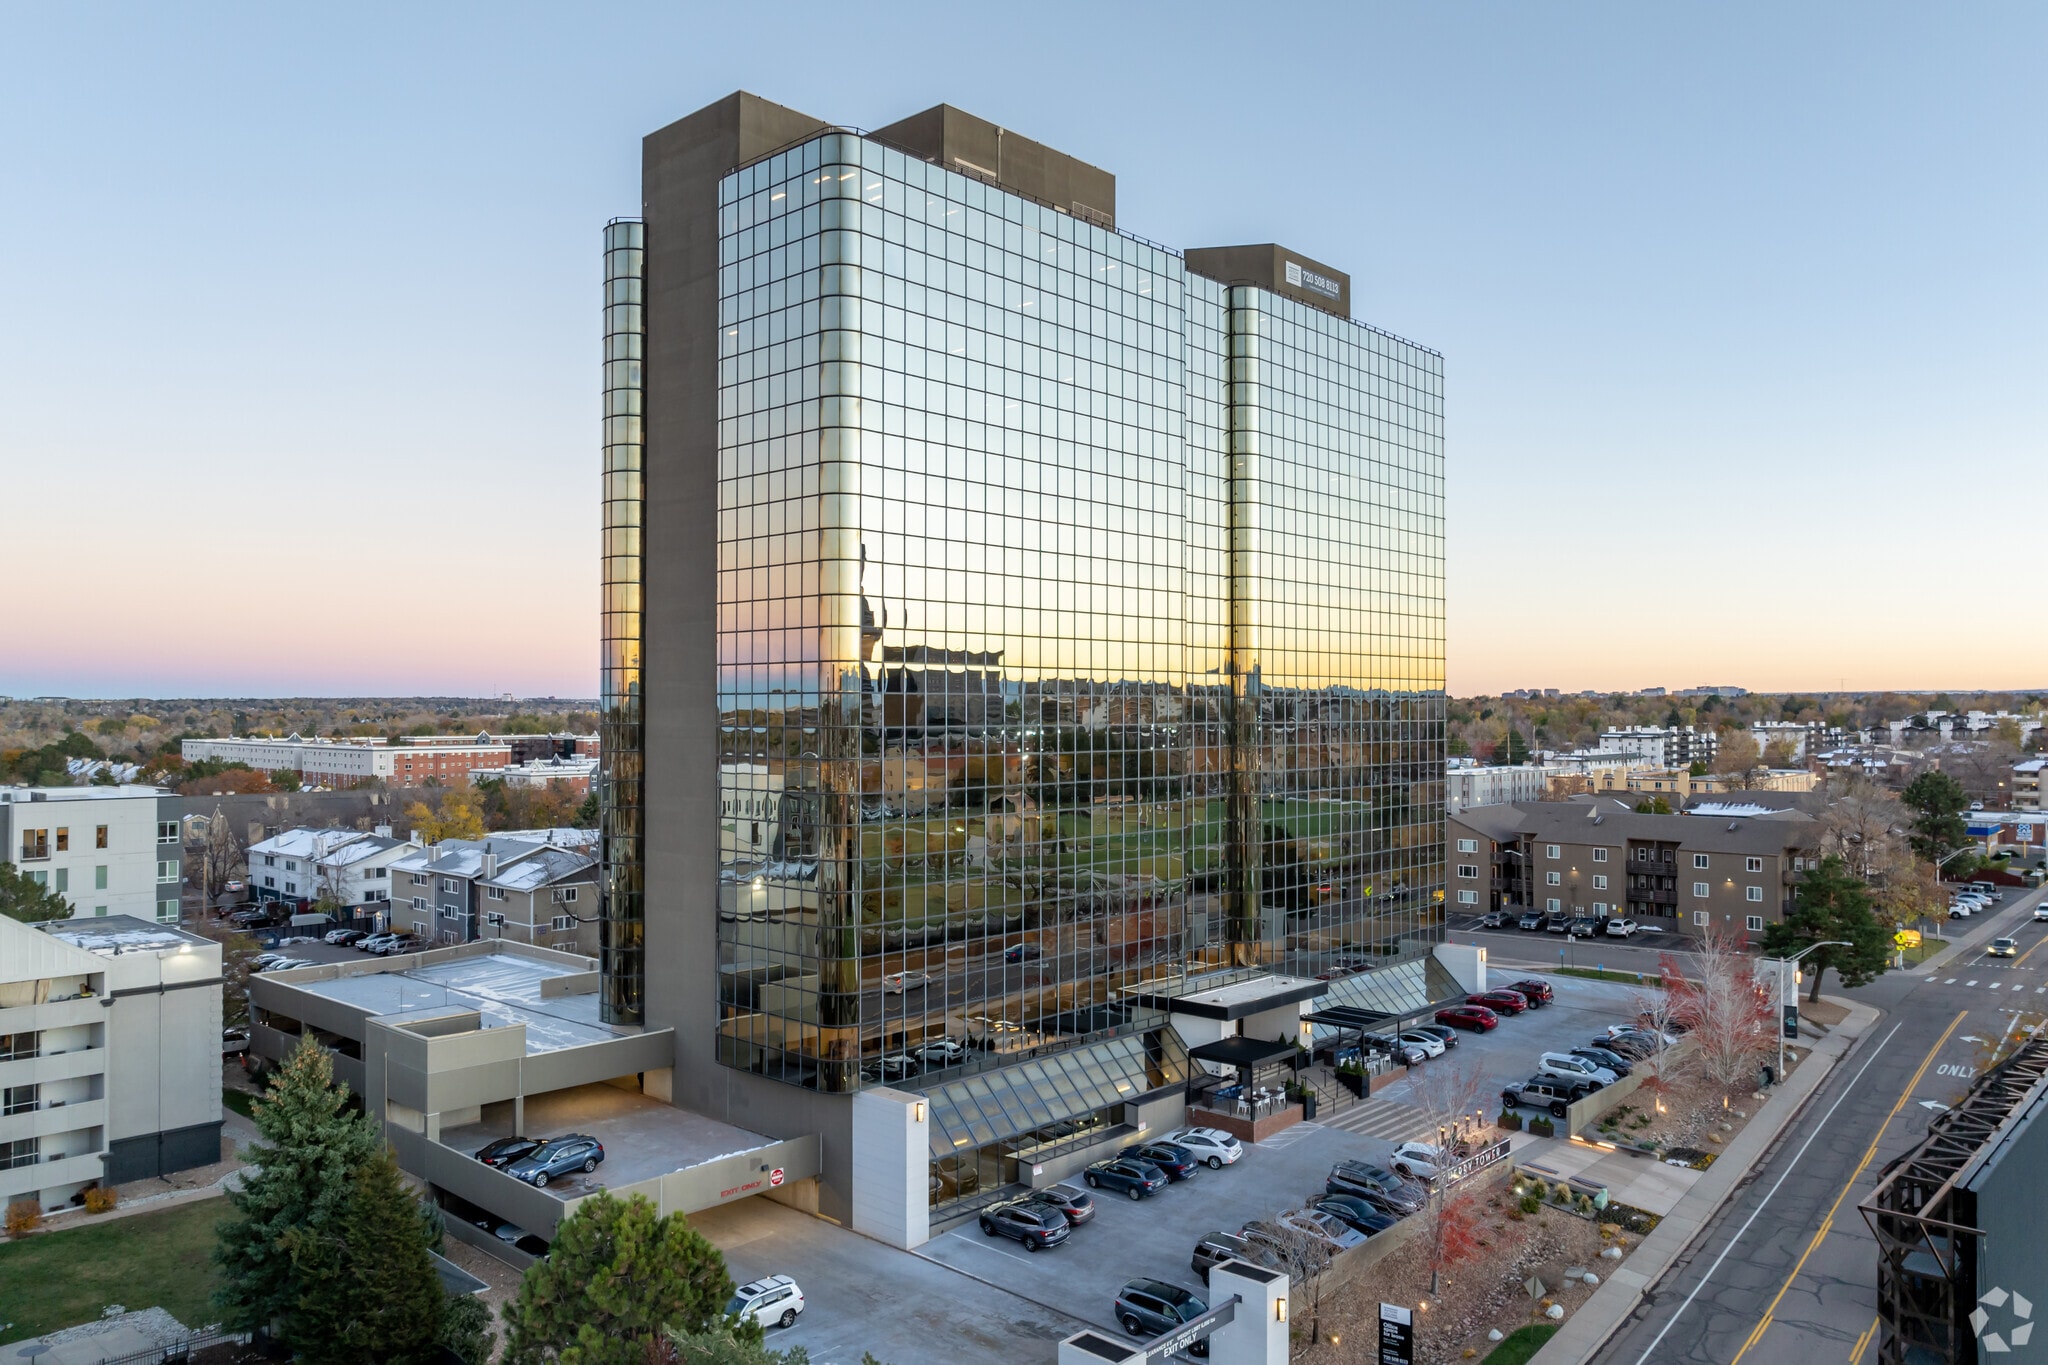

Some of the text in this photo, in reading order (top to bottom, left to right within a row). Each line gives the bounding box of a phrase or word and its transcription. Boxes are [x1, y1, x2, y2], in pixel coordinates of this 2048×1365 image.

[1302, 270, 1314, 284] 720
[1326, 280, 1339, 294] 8113
[1936, 1064, 1977, 1078] ONLY
[1475, 1148, 1501, 1166] TOWER
[720, 1181, 762, 1198] EXIT ONLY
[1163, 1332, 1197, 1358] EXIT ONLY
